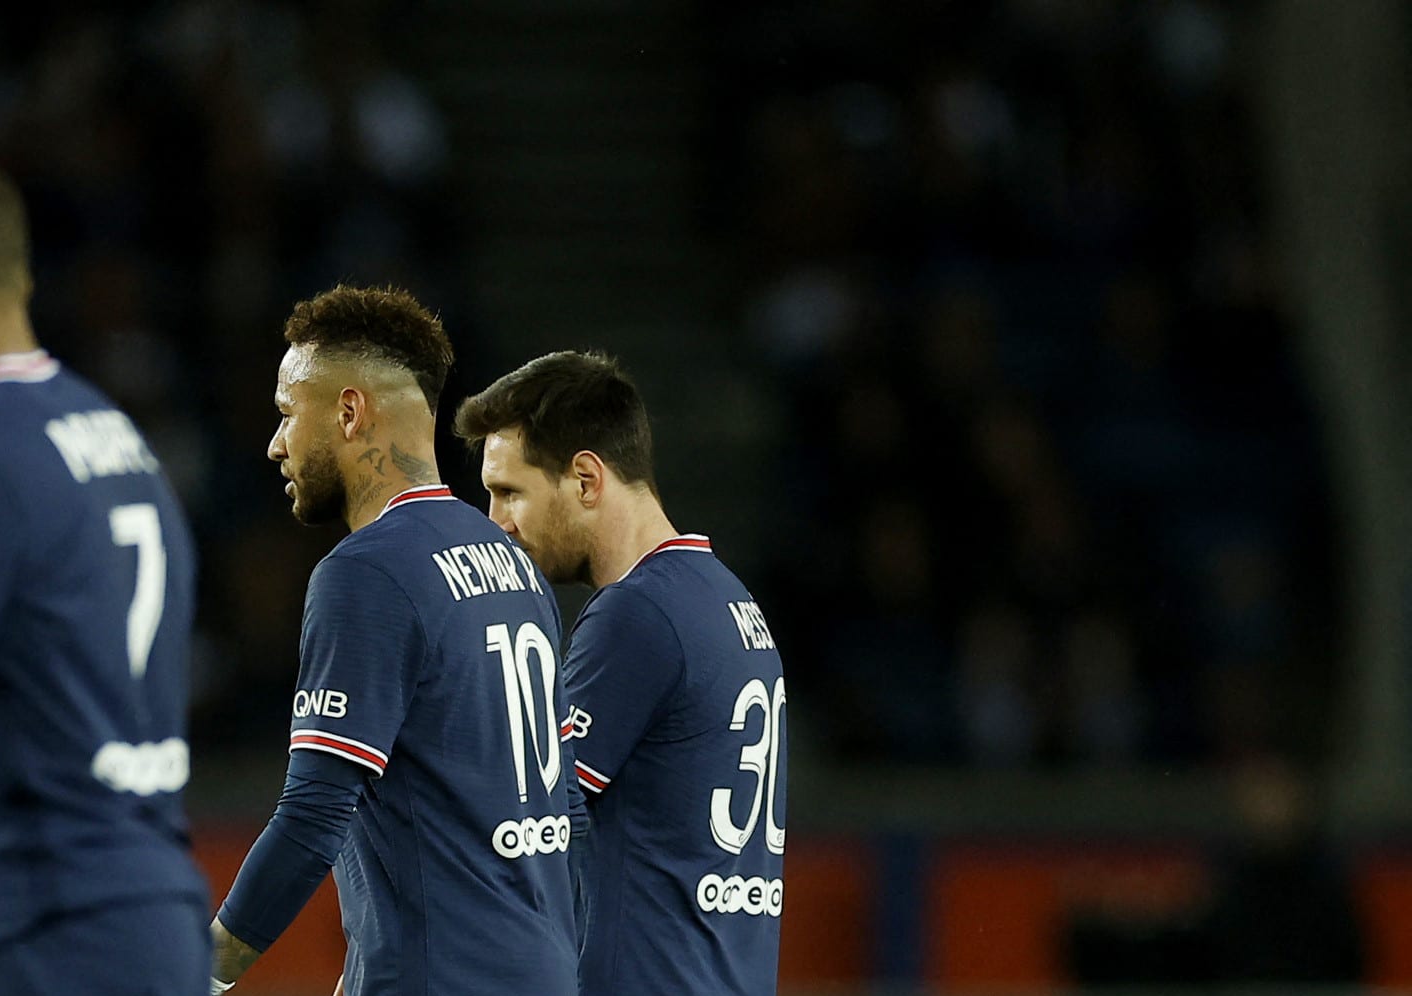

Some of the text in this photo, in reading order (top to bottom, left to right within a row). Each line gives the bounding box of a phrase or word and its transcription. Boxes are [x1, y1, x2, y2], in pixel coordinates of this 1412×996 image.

[109, 503, 167, 678] 7
[432, 542, 526, 602] NEYMAR
[293, 689, 348, 718] QNB
[486, 622, 562, 802] 10
[709, 676, 786, 855] 30
